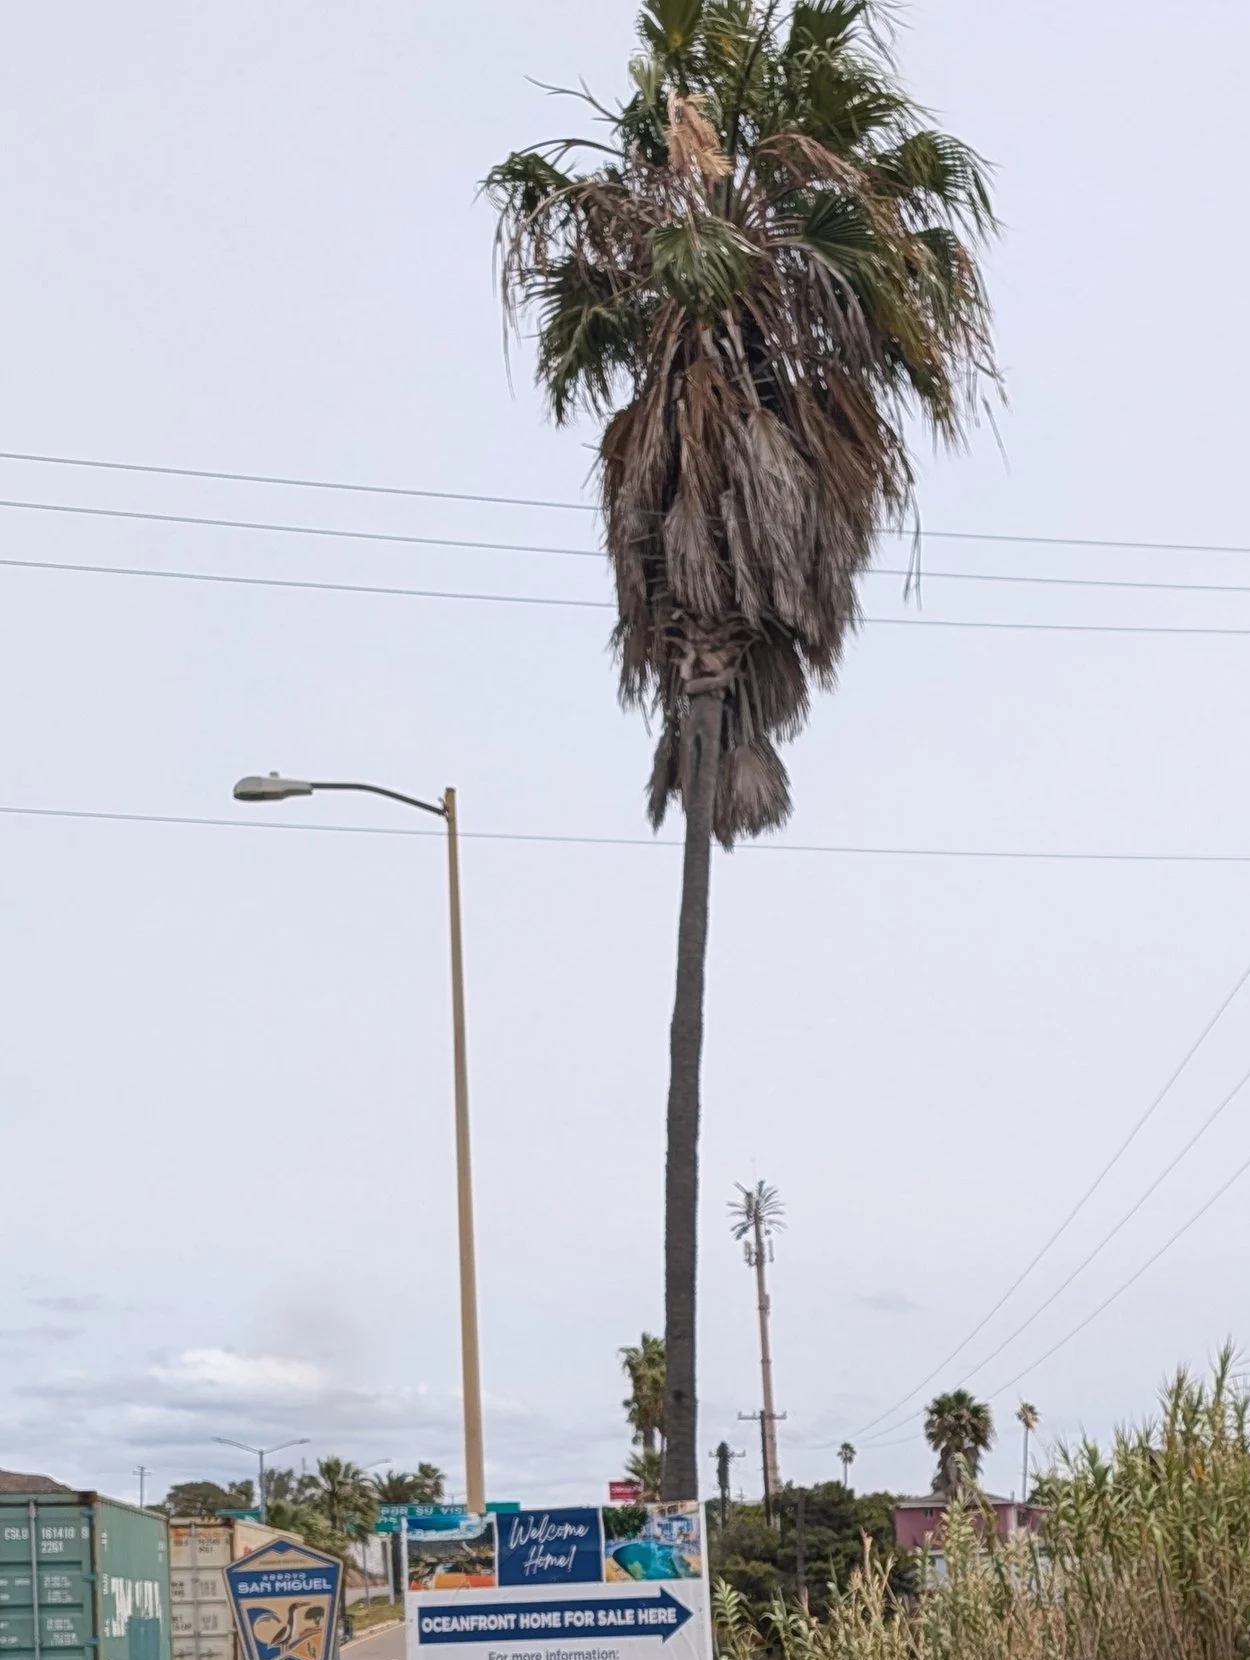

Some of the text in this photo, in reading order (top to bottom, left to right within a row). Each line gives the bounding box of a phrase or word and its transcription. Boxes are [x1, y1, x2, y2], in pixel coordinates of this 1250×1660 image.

[508, 1513, 590, 1550] Welcome
[523, 1544, 577, 1577] Home!
[237, 1578, 333, 1594] SAN MIGUEL
[421, 1606, 678, 1633] OCEANFRONT HOME FOR SALE HERE
